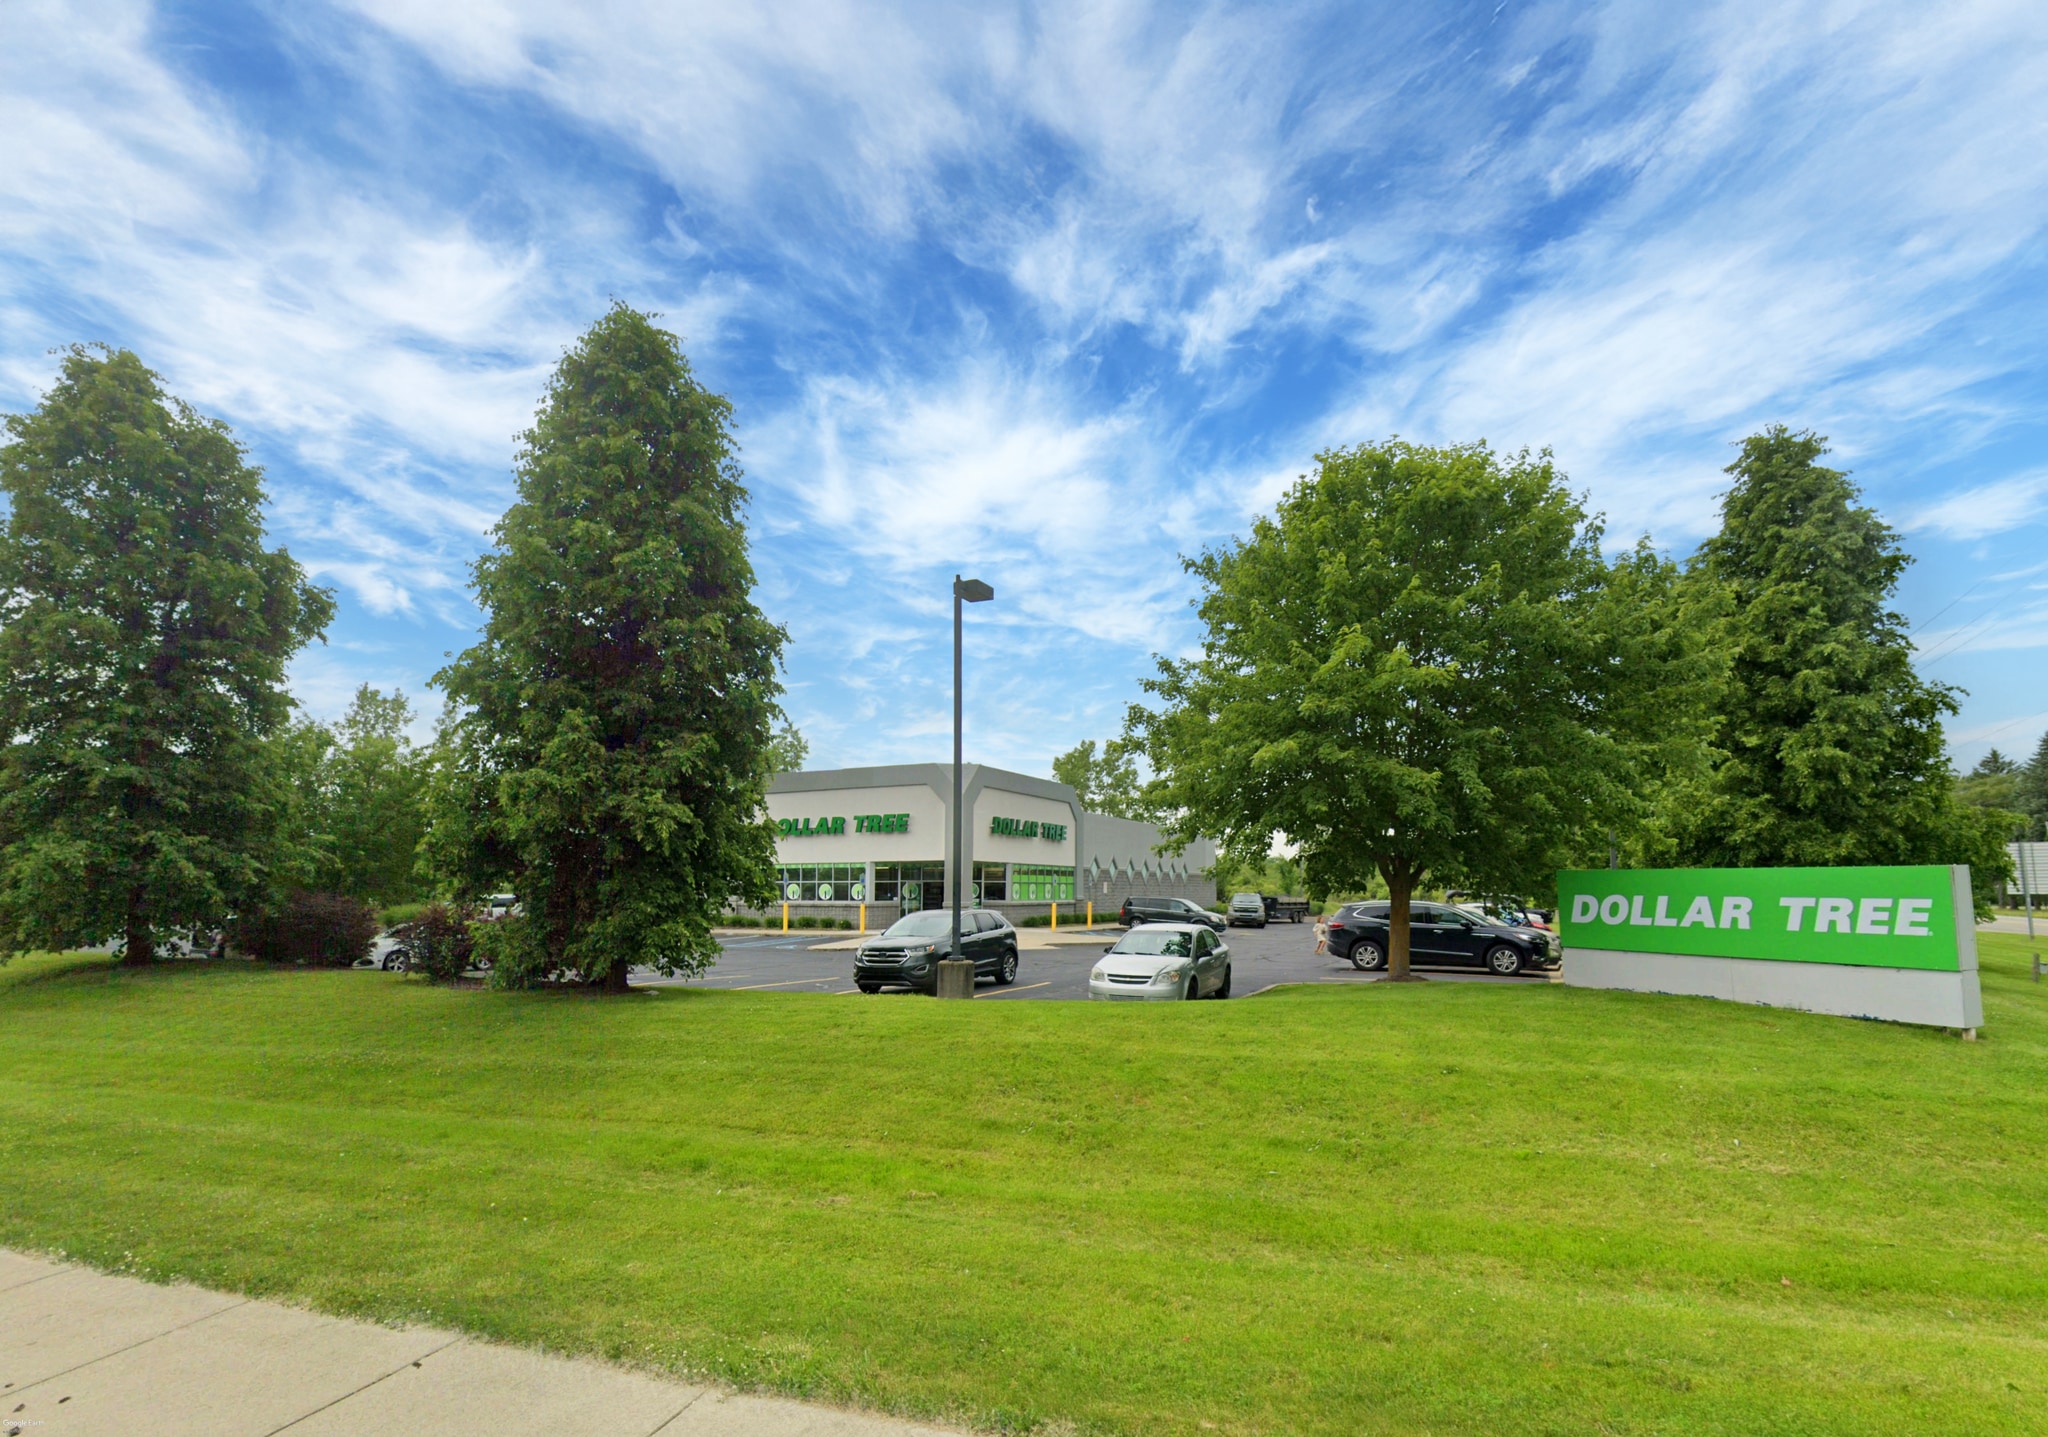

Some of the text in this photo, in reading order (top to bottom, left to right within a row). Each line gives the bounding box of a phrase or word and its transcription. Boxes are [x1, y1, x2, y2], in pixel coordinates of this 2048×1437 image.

[776, 813, 911, 837] OLLAR TREE
[990, 816, 1068, 842] DOLLAR TREE
[1570, 894, 1934, 937] DOLLAR TREE
